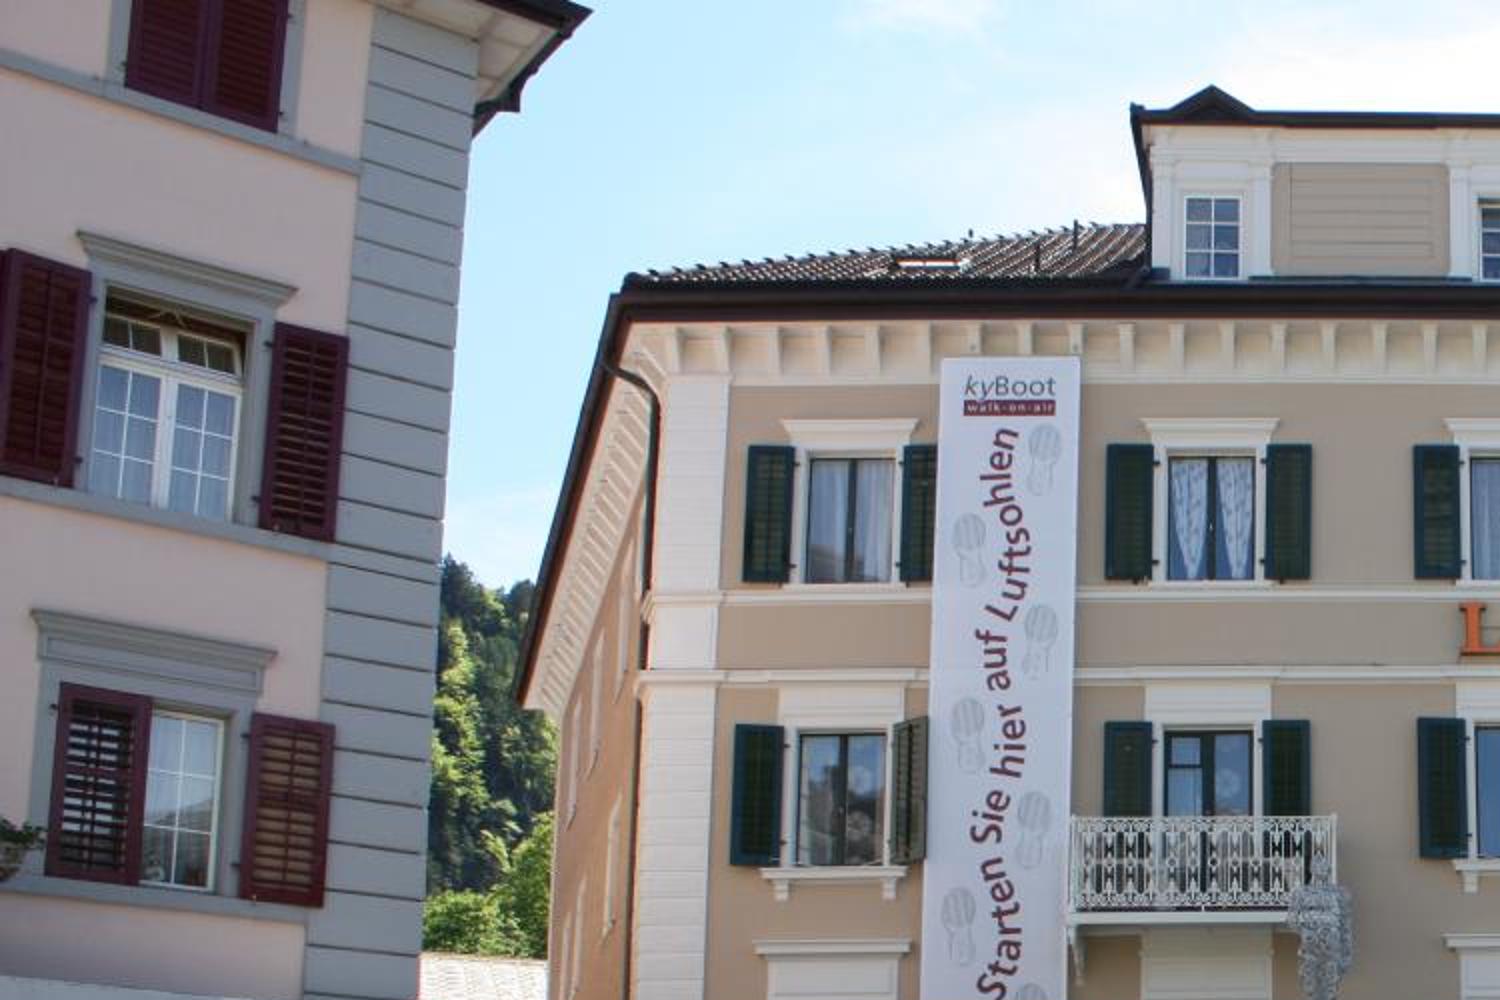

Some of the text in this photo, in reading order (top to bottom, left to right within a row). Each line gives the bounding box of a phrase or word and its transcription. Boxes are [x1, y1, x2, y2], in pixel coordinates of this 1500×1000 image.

[964, 375, 1056, 400] kyBoot
[979, 427, 1032, 623] Luftsohlen
[975, 626, 1012, 693] auf
[989, 703, 1027, 781] hier
[969, 789, 1012, 845] Sie
